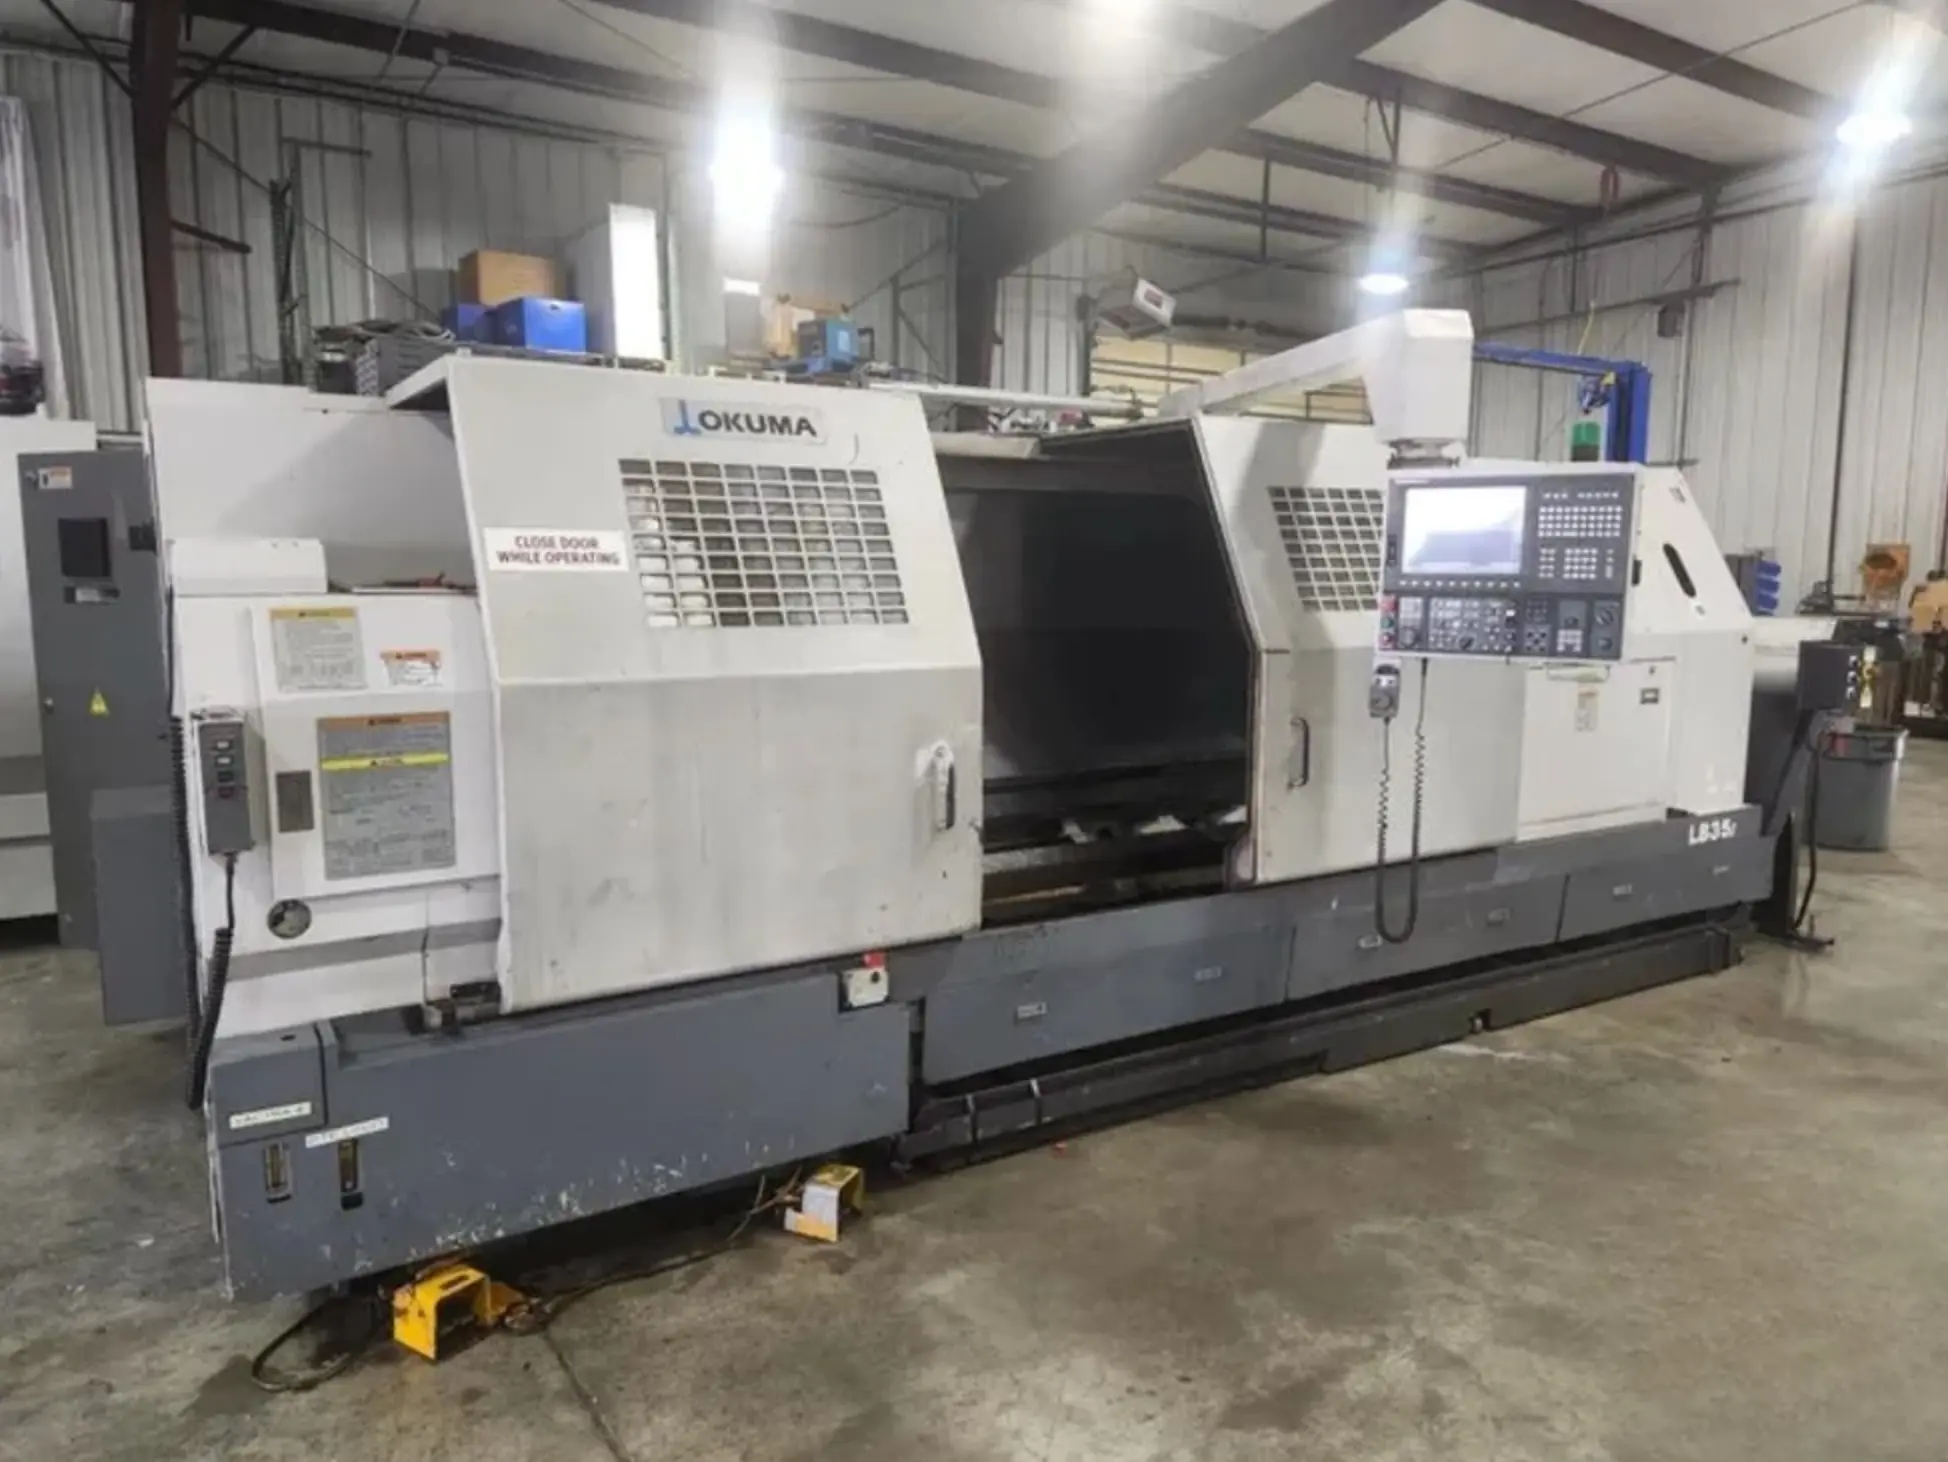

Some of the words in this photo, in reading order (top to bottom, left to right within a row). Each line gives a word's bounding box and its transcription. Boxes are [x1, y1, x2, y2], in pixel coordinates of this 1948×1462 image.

[698, 409, 818, 438] OKUMA
[514, 535, 556, 550] CLOSE
[559, 536, 600, 550] DOOR
[496, 551, 542, 564] WHILE
[544, 551, 621, 566] OPERATING
